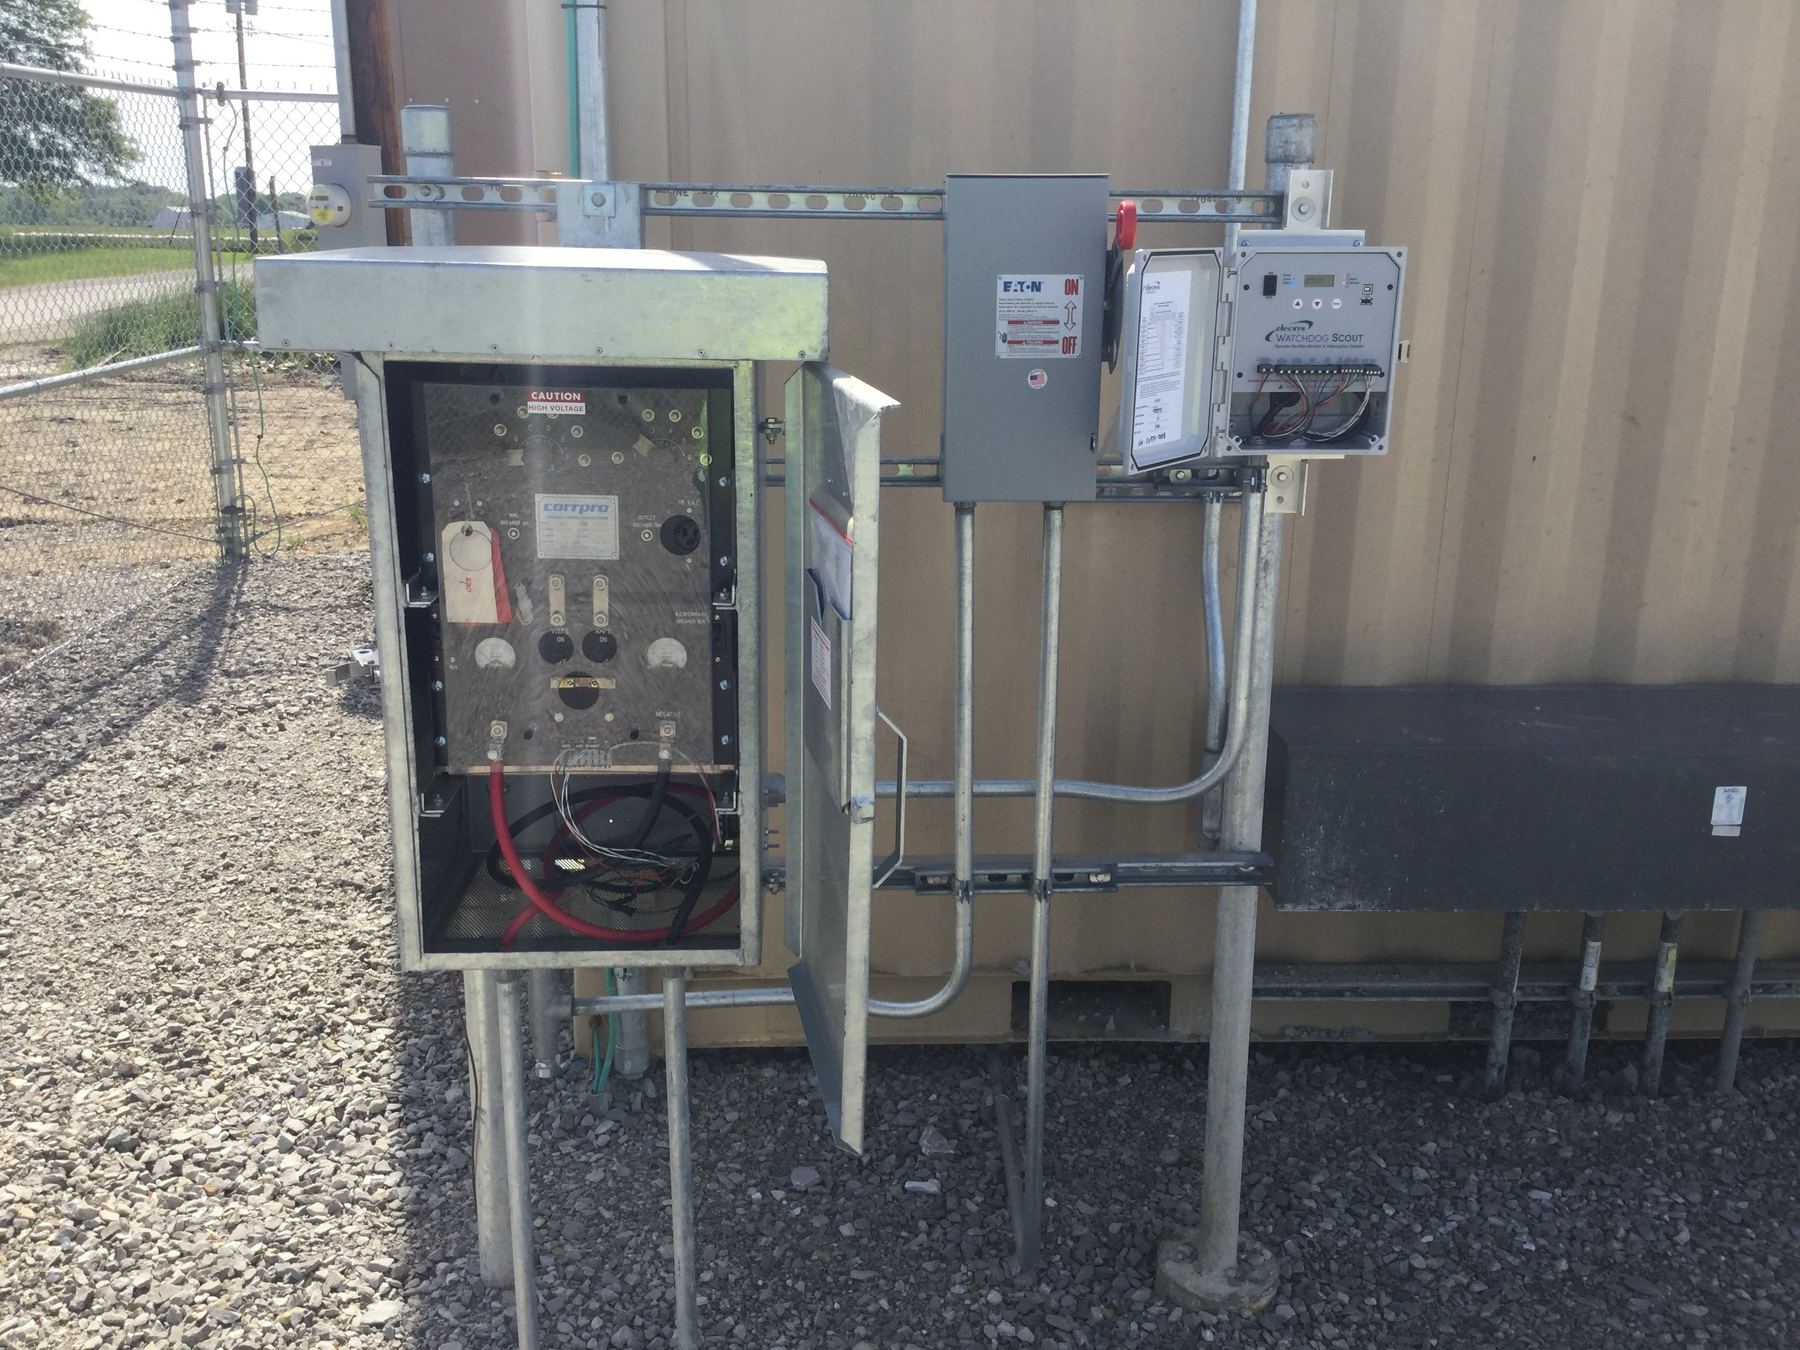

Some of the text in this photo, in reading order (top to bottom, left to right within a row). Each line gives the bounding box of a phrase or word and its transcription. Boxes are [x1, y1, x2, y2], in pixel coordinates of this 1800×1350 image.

[1003, 281, 1041, 292] EATON
[1064, 279, 1079, 296] ON
[1062, 336, 1078, 354] OFF
[531, 391, 581, 401] CAUTION
[528, 404, 584, 412] HIGH VOLTAGE
[543, 503, 609, 514] corrpro
